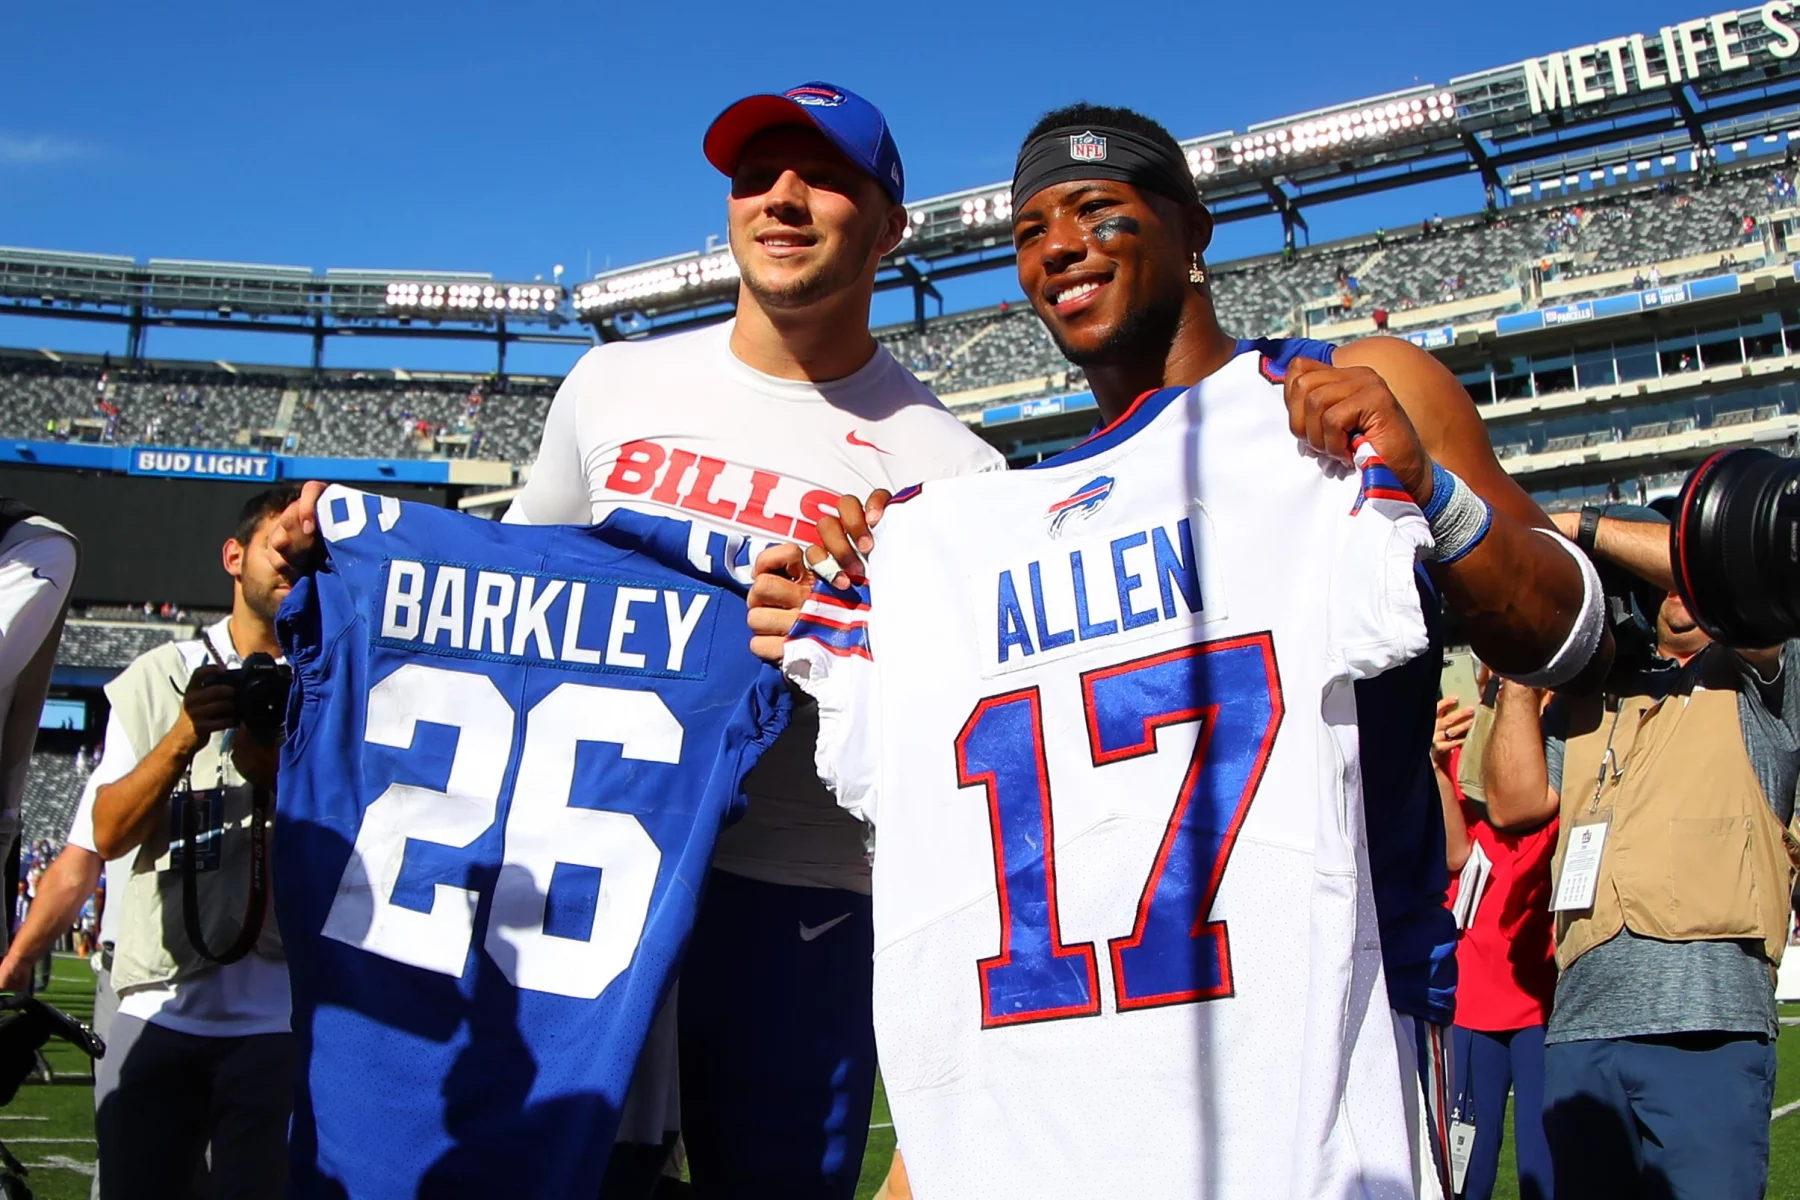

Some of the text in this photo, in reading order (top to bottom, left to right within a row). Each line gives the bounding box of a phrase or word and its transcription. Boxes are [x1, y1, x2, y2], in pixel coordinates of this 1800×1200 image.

[1523, 10, 1749, 115] METLIFE
[1076, 143, 1103, 157] NFL
[138, 451, 268, 477] BUD LIGHT
[380, 558, 710, 673] BARKLEY
[997, 516, 1204, 664] ALLEN
[320, 662, 685, 1000] 26
[953, 630, 1286, 1031] 17
